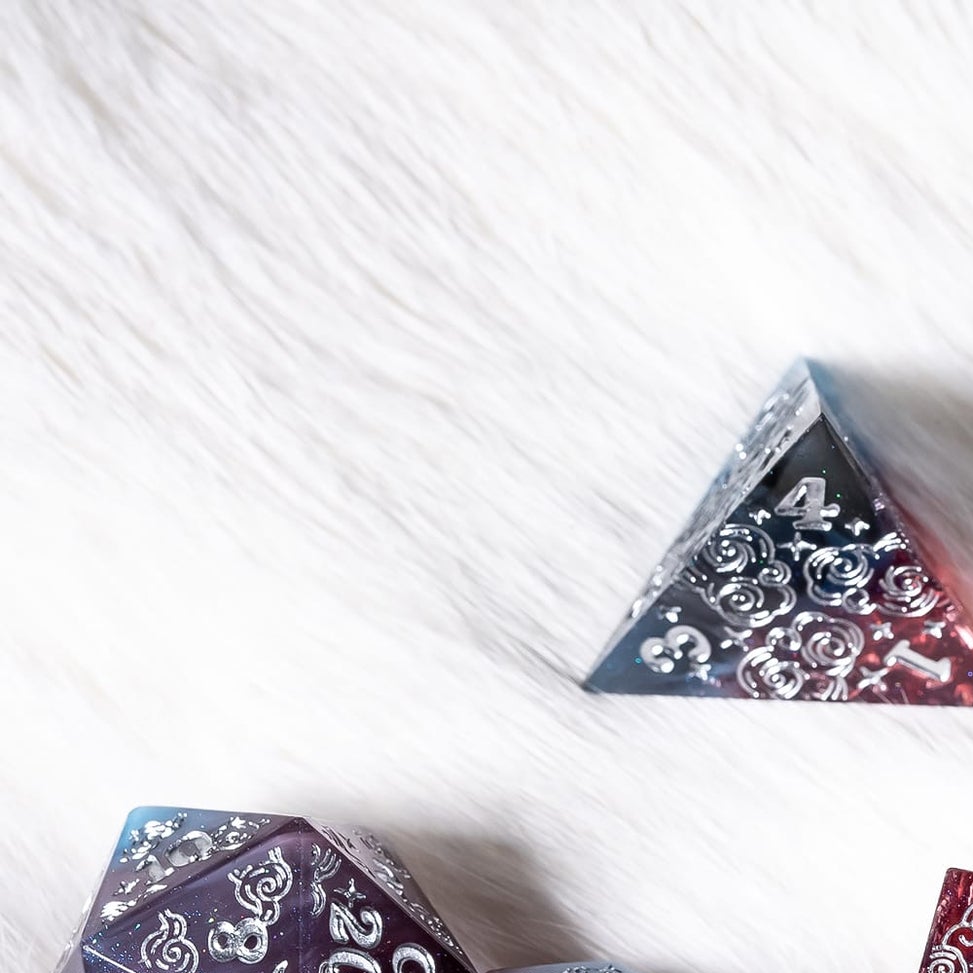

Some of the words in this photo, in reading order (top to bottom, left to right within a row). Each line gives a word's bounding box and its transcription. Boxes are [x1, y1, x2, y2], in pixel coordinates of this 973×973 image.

[775, 477, 841, 531] 4
[640, 625, 711, 674] 3
[884, 640, 951, 682] 1
[135, 830, 213, 884] 10
[207, 917, 269, 965] 8
